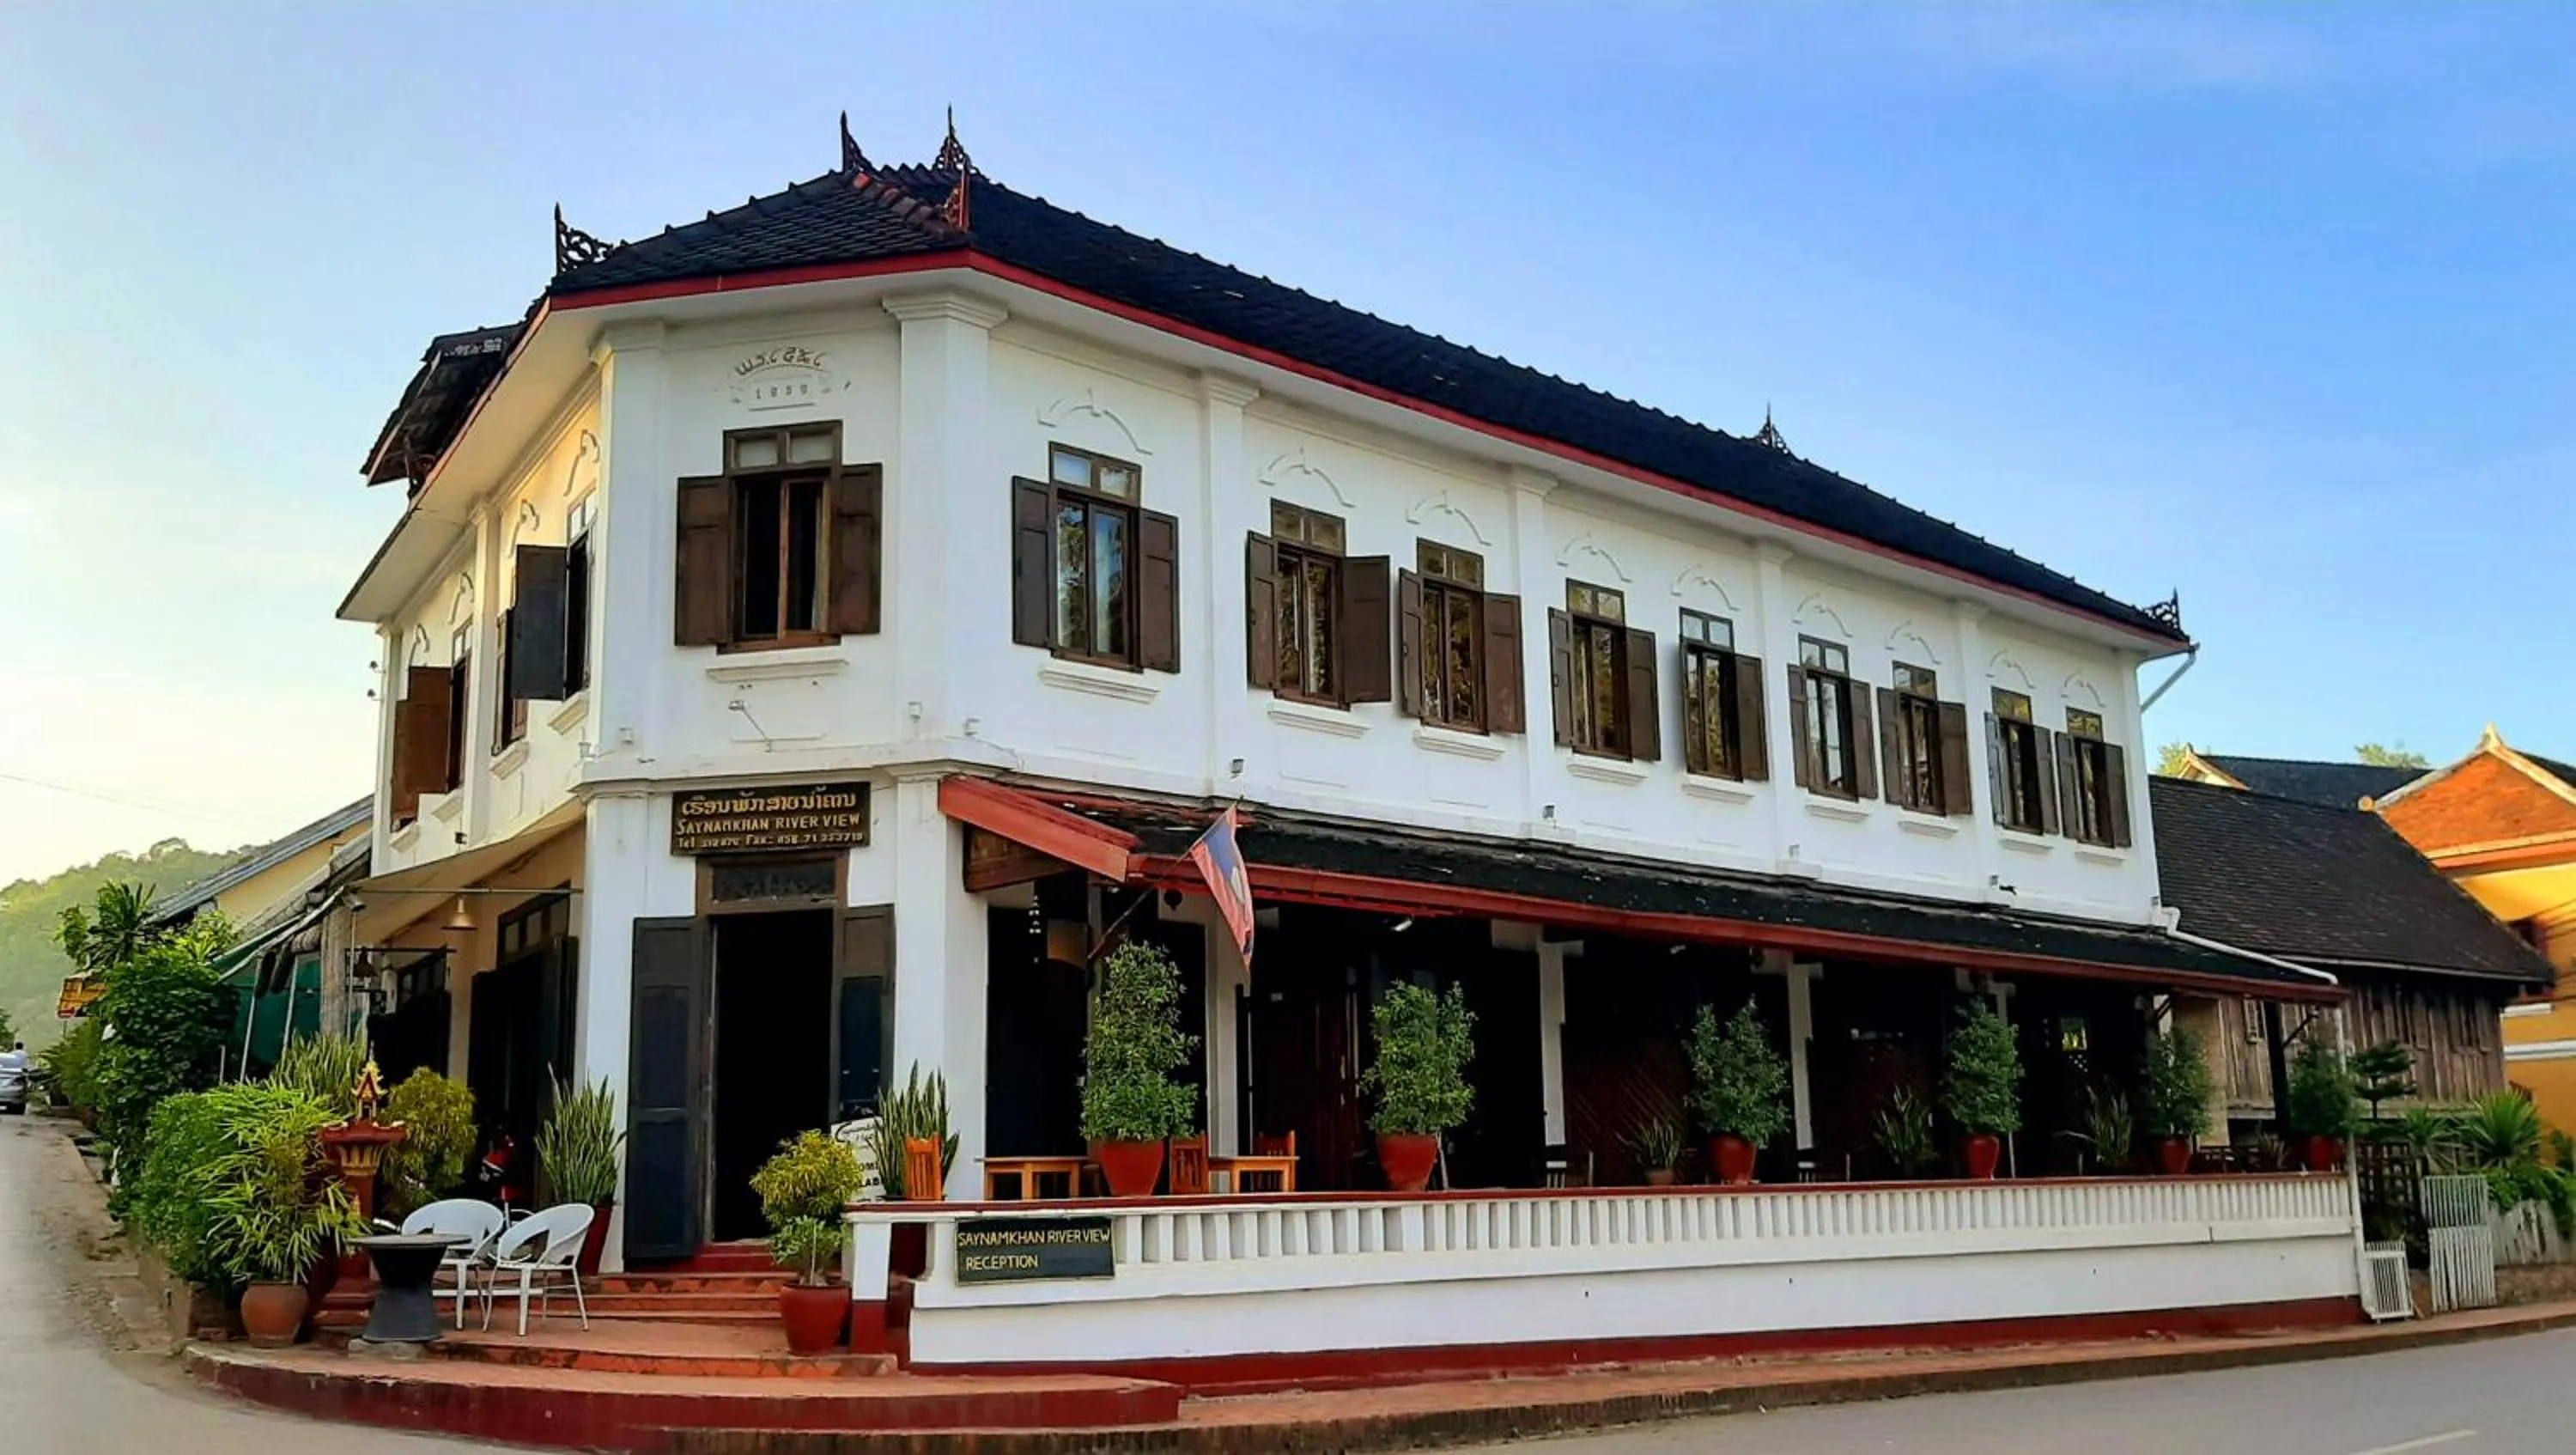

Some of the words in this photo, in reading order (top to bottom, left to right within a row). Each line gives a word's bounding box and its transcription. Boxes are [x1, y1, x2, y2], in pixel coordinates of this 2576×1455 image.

[676, 817, 769, 836] SAYNAMKHAN
[775, 814, 819, 830] RIVER
[823, 813, 860, 827] VIEW
[957, 1230, 1045, 1246] SAYNAMKHAN
[1047, 1229, 1082, 1245] RIVER
[1082, 1227, 1111, 1243] VIEW
[965, 1255, 1039, 1271] RECEPTION
